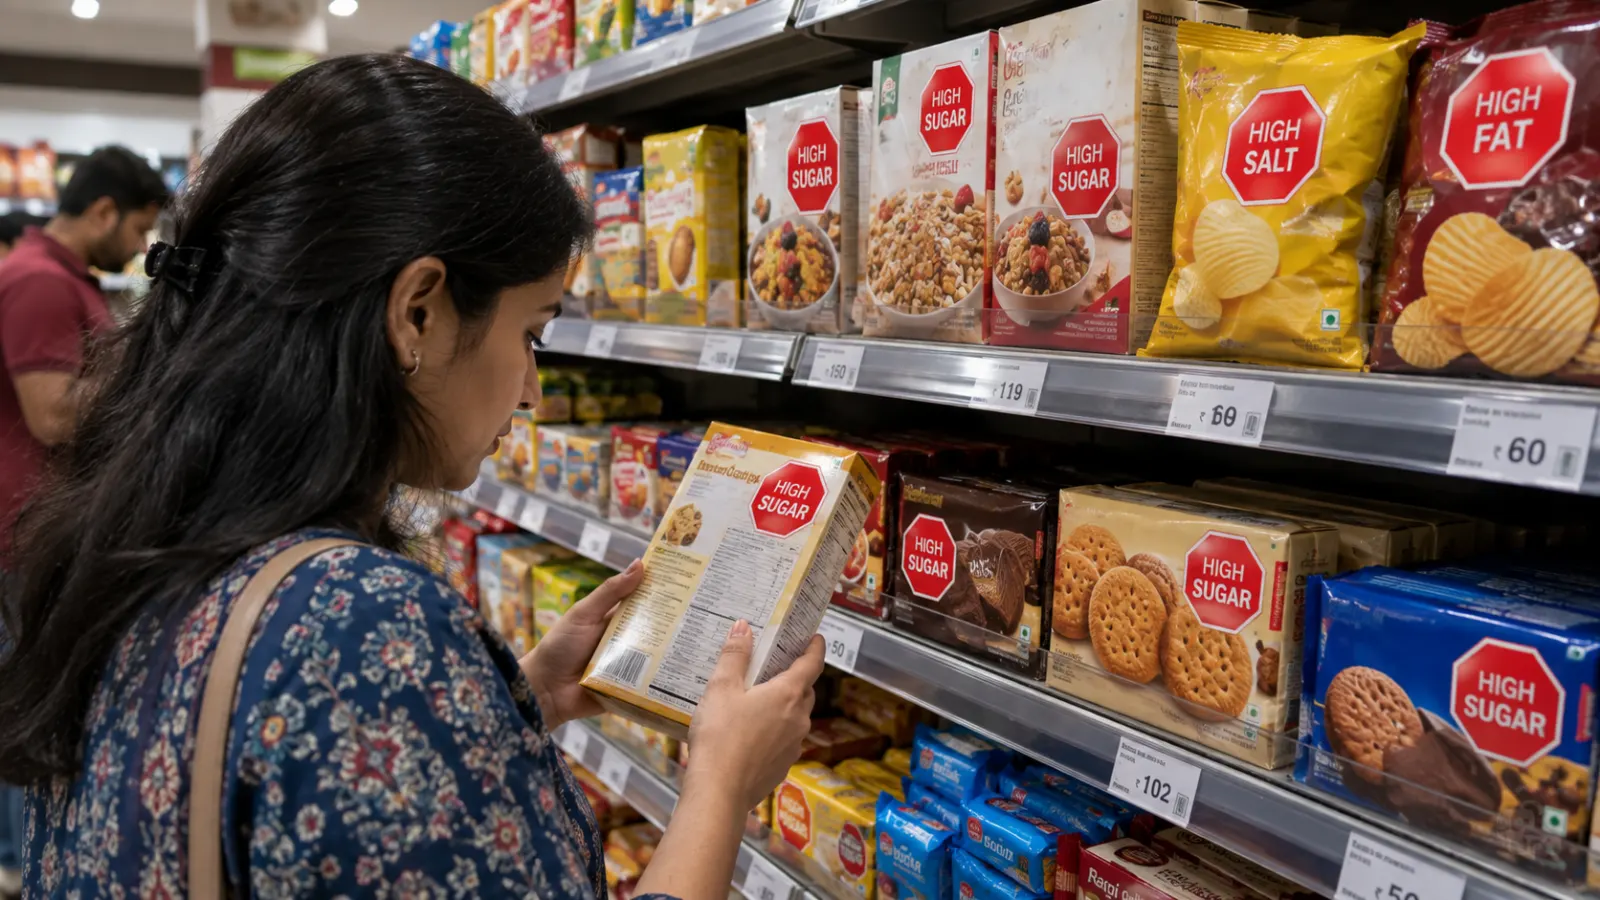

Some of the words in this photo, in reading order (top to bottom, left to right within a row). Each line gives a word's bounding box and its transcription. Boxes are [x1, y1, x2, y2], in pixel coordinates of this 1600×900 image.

[932, 87, 961, 107] HIGH
[1475, 84, 1542, 117] HIGH
[924, 107, 966, 131] SUGAR
[1248, 118, 1302, 144] HIGH
[1473, 118, 1534, 153] FAT
[798, 143, 826, 164] HIGH
[1066, 143, 1103, 165] HIGH
[1243, 147, 1299, 175] SALT
[792, 166, 832, 189] SUGAR
[1058, 167, 1110, 192] SUGAR
[830, 363, 846, 379] 150
[1000, 381, 1023, 401] 119
[1508, 436, 1547, 466] 60
[773, 479, 811, 500] HIGH
[757, 495, 809, 520] SUGAR
[915, 536, 943, 556] HIGH
[908, 554, 948, 579] SUGAR
[1203, 556, 1244, 582] HIGH
[1192, 578, 1252, 610] SUGAR
[831, 640, 845, 658] 50
[1478, 671, 1535, 704] HIGH
[1463, 694, 1546, 737] SUGAR
[1143, 775, 1171, 804] 102
[1388, 883, 1420, 900] 5
